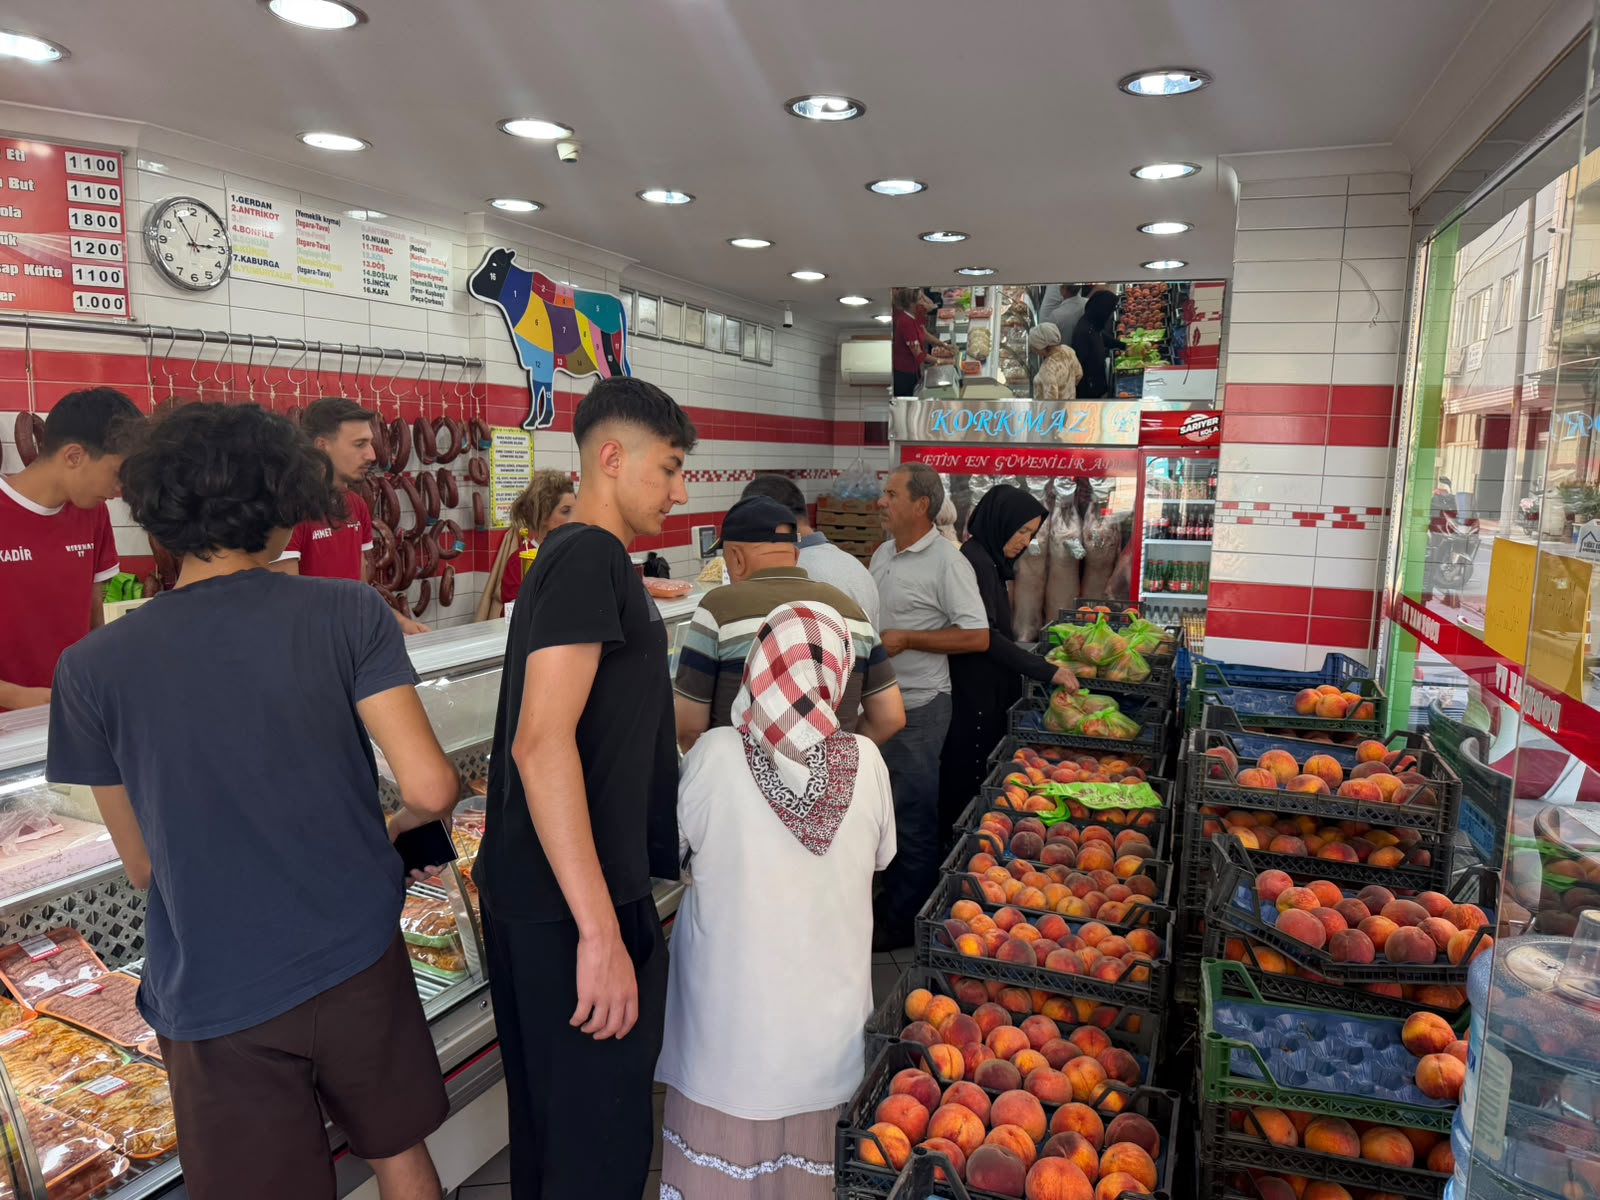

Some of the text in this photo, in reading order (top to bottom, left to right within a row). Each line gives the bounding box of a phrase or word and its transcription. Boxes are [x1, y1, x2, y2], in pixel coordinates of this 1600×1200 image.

[69, 156, 116, 173] 1100
[8, 177, 35, 191] But
[70, 184, 118, 200] 1100
[231, 194, 273, 210] 1.GERDAN
[231, 204, 280, 221] 2.ANTRİKOT
[71, 213, 118, 228] 1800
[163, 219, 172, 229] 10
[213, 228, 221, 238] 2
[159, 235, 168, 244] 9
[361, 233, 390, 246] 10.NUAR
[73, 240, 119, 256] 1200
[217, 245, 226, 255] 3
[164, 252, 174, 262] 8
[233, 254, 280, 269] 7.KABURGA
[214, 260, 222, 269] 4
[24, 263, 63, 278] Köfte
[75, 268, 120, 283] 1100
[176, 266, 184, 276] 7
[204, 271, 213, 280] 5
[489, 272, 497, 280] 16
[190, 273, 199, 282] 6
[363, 286, 390, 297] 16.KAFA
[541, 284, 546, 293] 2
[76, 296, 123, 310] 1.000
[557, 358, 563, 366] 13
[930, 407, 1090, 436] KORKMAZ
[1180, 416, 1219, 434] SARIYER
[964, 455, 991, 468] EN
[994, 453, 1088, 472] GÜVENİLİR
